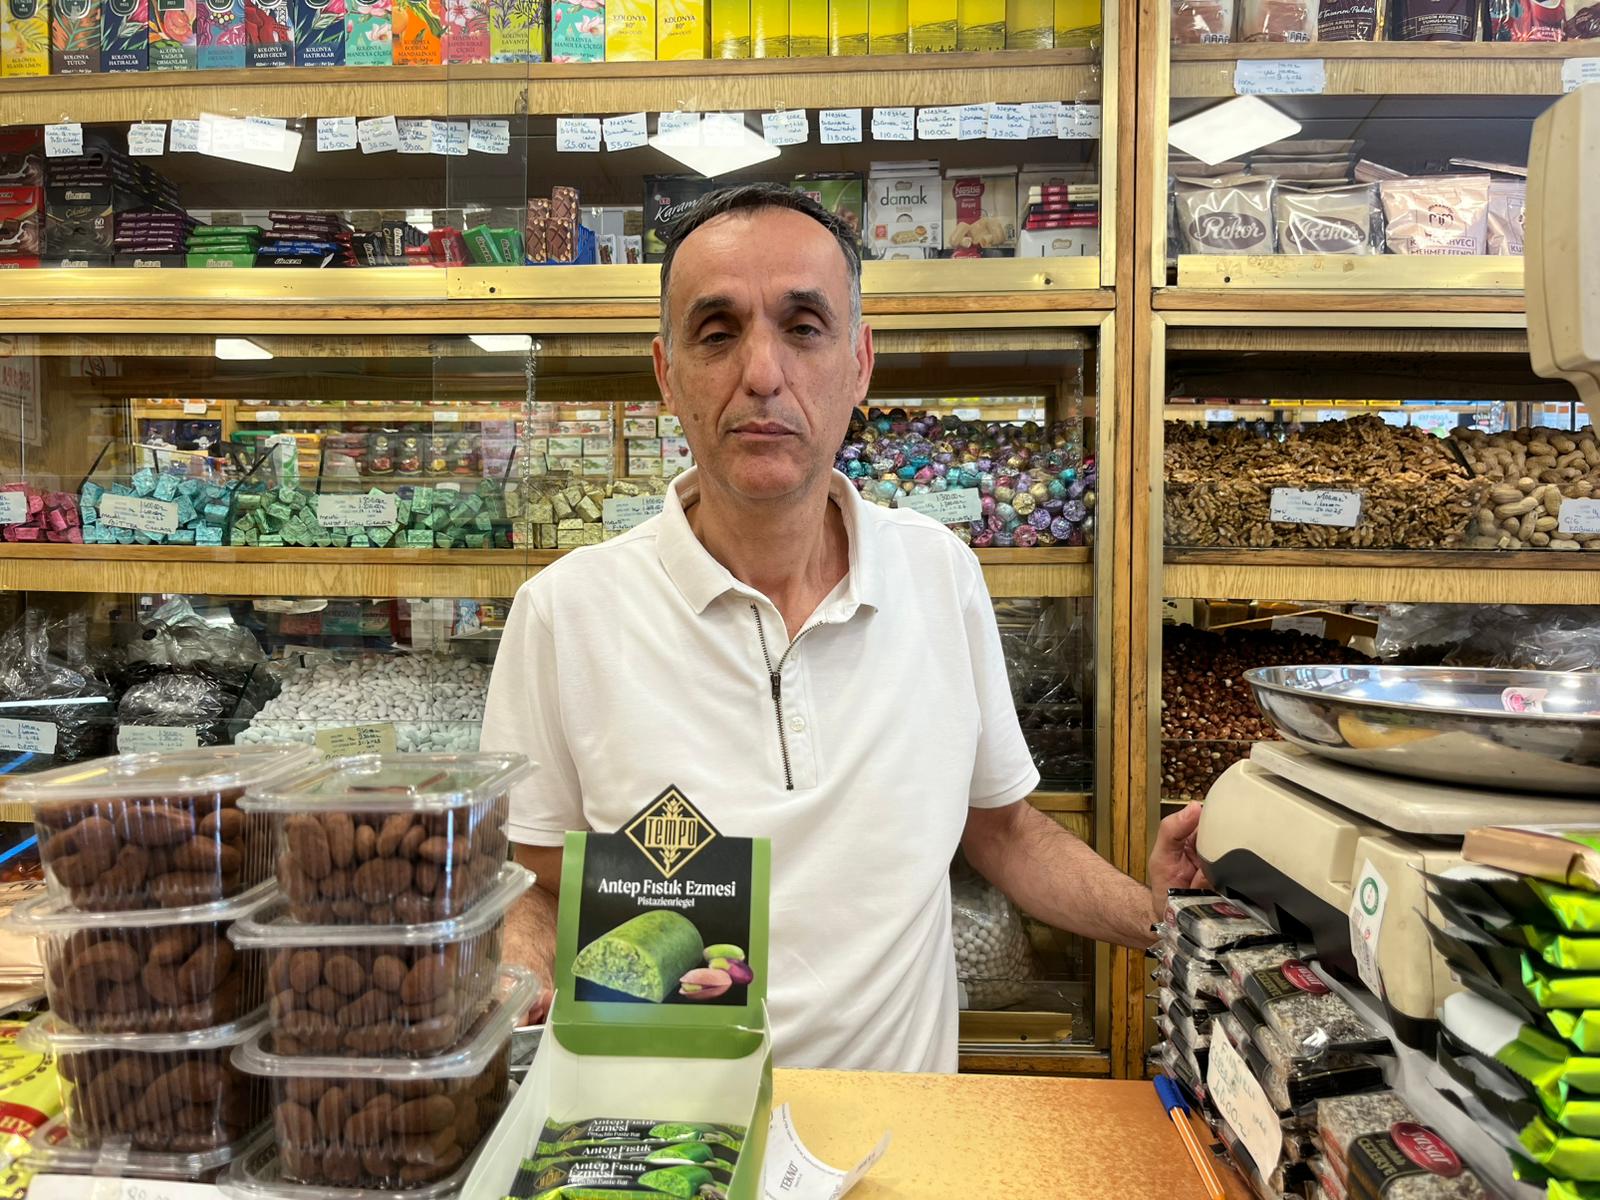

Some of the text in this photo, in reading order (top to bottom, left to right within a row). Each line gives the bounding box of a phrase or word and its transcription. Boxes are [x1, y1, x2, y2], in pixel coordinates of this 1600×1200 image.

[664, 16, 696, 24] KOLONYA
[880, 184, 928, 206] damak
[1194, 212, 1265, 240] Rekor
[647, 817, 697, 847] TEMPO
[597, 877, 737, 898] Antep Fıstık Ezmesi
[636, 896, 696, 909] Pistazienriegel
[587, 1124, 629, 1132] Ezmesi
[592, 1119, 624, 1127] Antep
[582, 1146, 618, 1158] Antep
[1357, 1137, 1398, 1176] CEZERYE
[571, 1161, 647, 1173] Antep Fıstık
